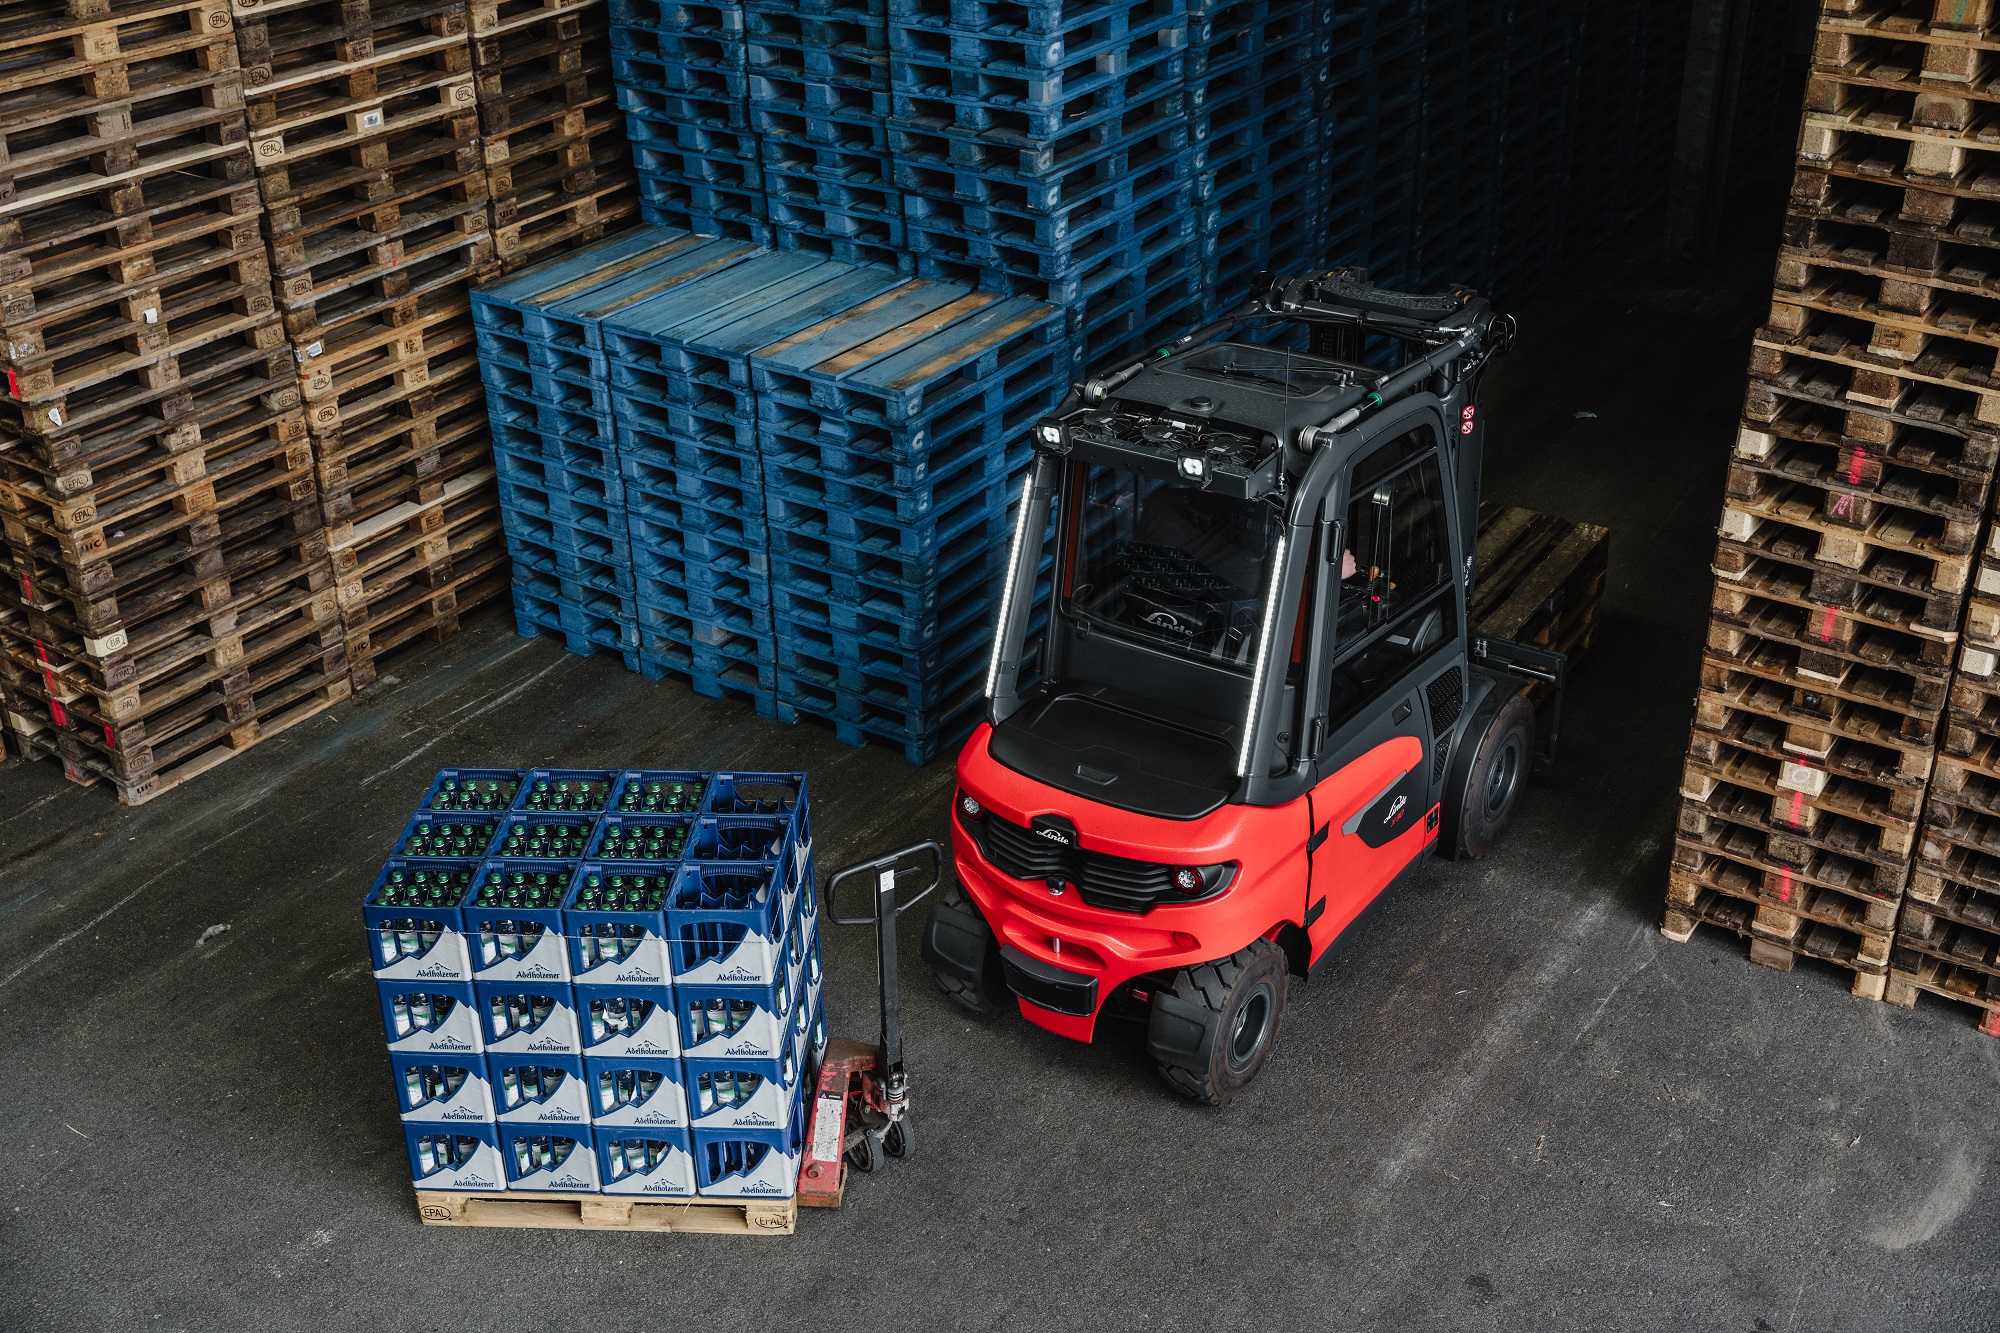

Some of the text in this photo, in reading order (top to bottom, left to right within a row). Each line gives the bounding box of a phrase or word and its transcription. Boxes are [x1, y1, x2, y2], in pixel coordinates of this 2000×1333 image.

[211, 14, 227, 26] EPAL
[250, 69, 267, 82] EPAL
[262, 143, 277, 155] EPAL
[495, 179, 508, 190] EPAL
[294, 282, 307, 294] EPAL
[8, 303, 26, 315] EPAL
[253, 299, 268, 311] EPAL
[312, 376, 328, 389] EPAL
[280, 393, 295, 405] EPAL
[319, 408, 335, 421] EPAL
[287, 422, 302, 434] EUR
[73, 510, 91, 523] EPAL
[1137, 612, 1194, 637] Linde
[109, 637, 121, 648] EUR
[1383, 795, 1408, 825] Linde
[1036, 828, 1069, 845] Linde
[424, 1208, 447, 1218] EPAL
[760, 1216, 783, 1226] EPAL
